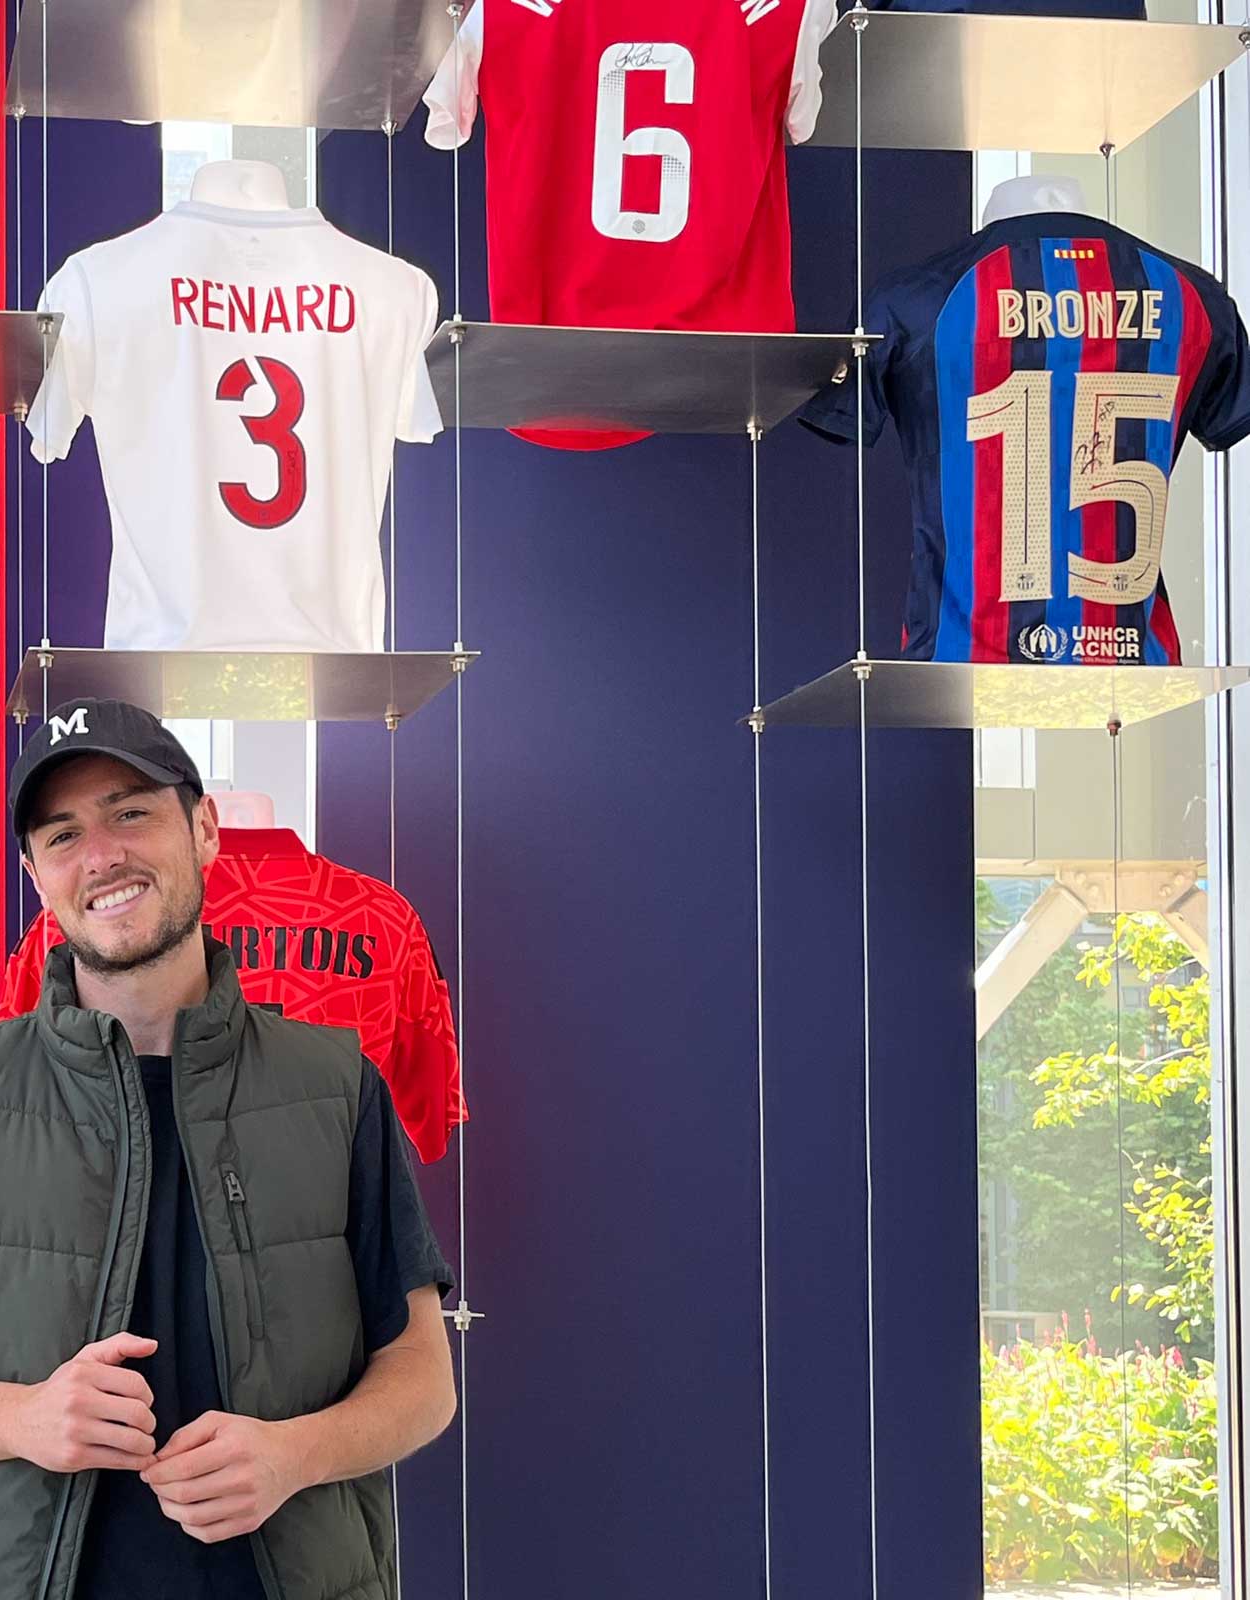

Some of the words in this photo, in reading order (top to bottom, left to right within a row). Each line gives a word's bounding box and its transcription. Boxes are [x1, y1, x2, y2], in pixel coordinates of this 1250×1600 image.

[591, 42, 694, 243] 6
[170, 277, 356, 334] RENARD
[998, 290, 1164, 339] BRONZE
[216, 355, 307, 530] 3
[966, 370, 1181, 604] 15
[1072, 641, 1140, 657] ACNUR
[1073, 626, 1139, 641] UNHCR
[48, 707, 89, 746] M
